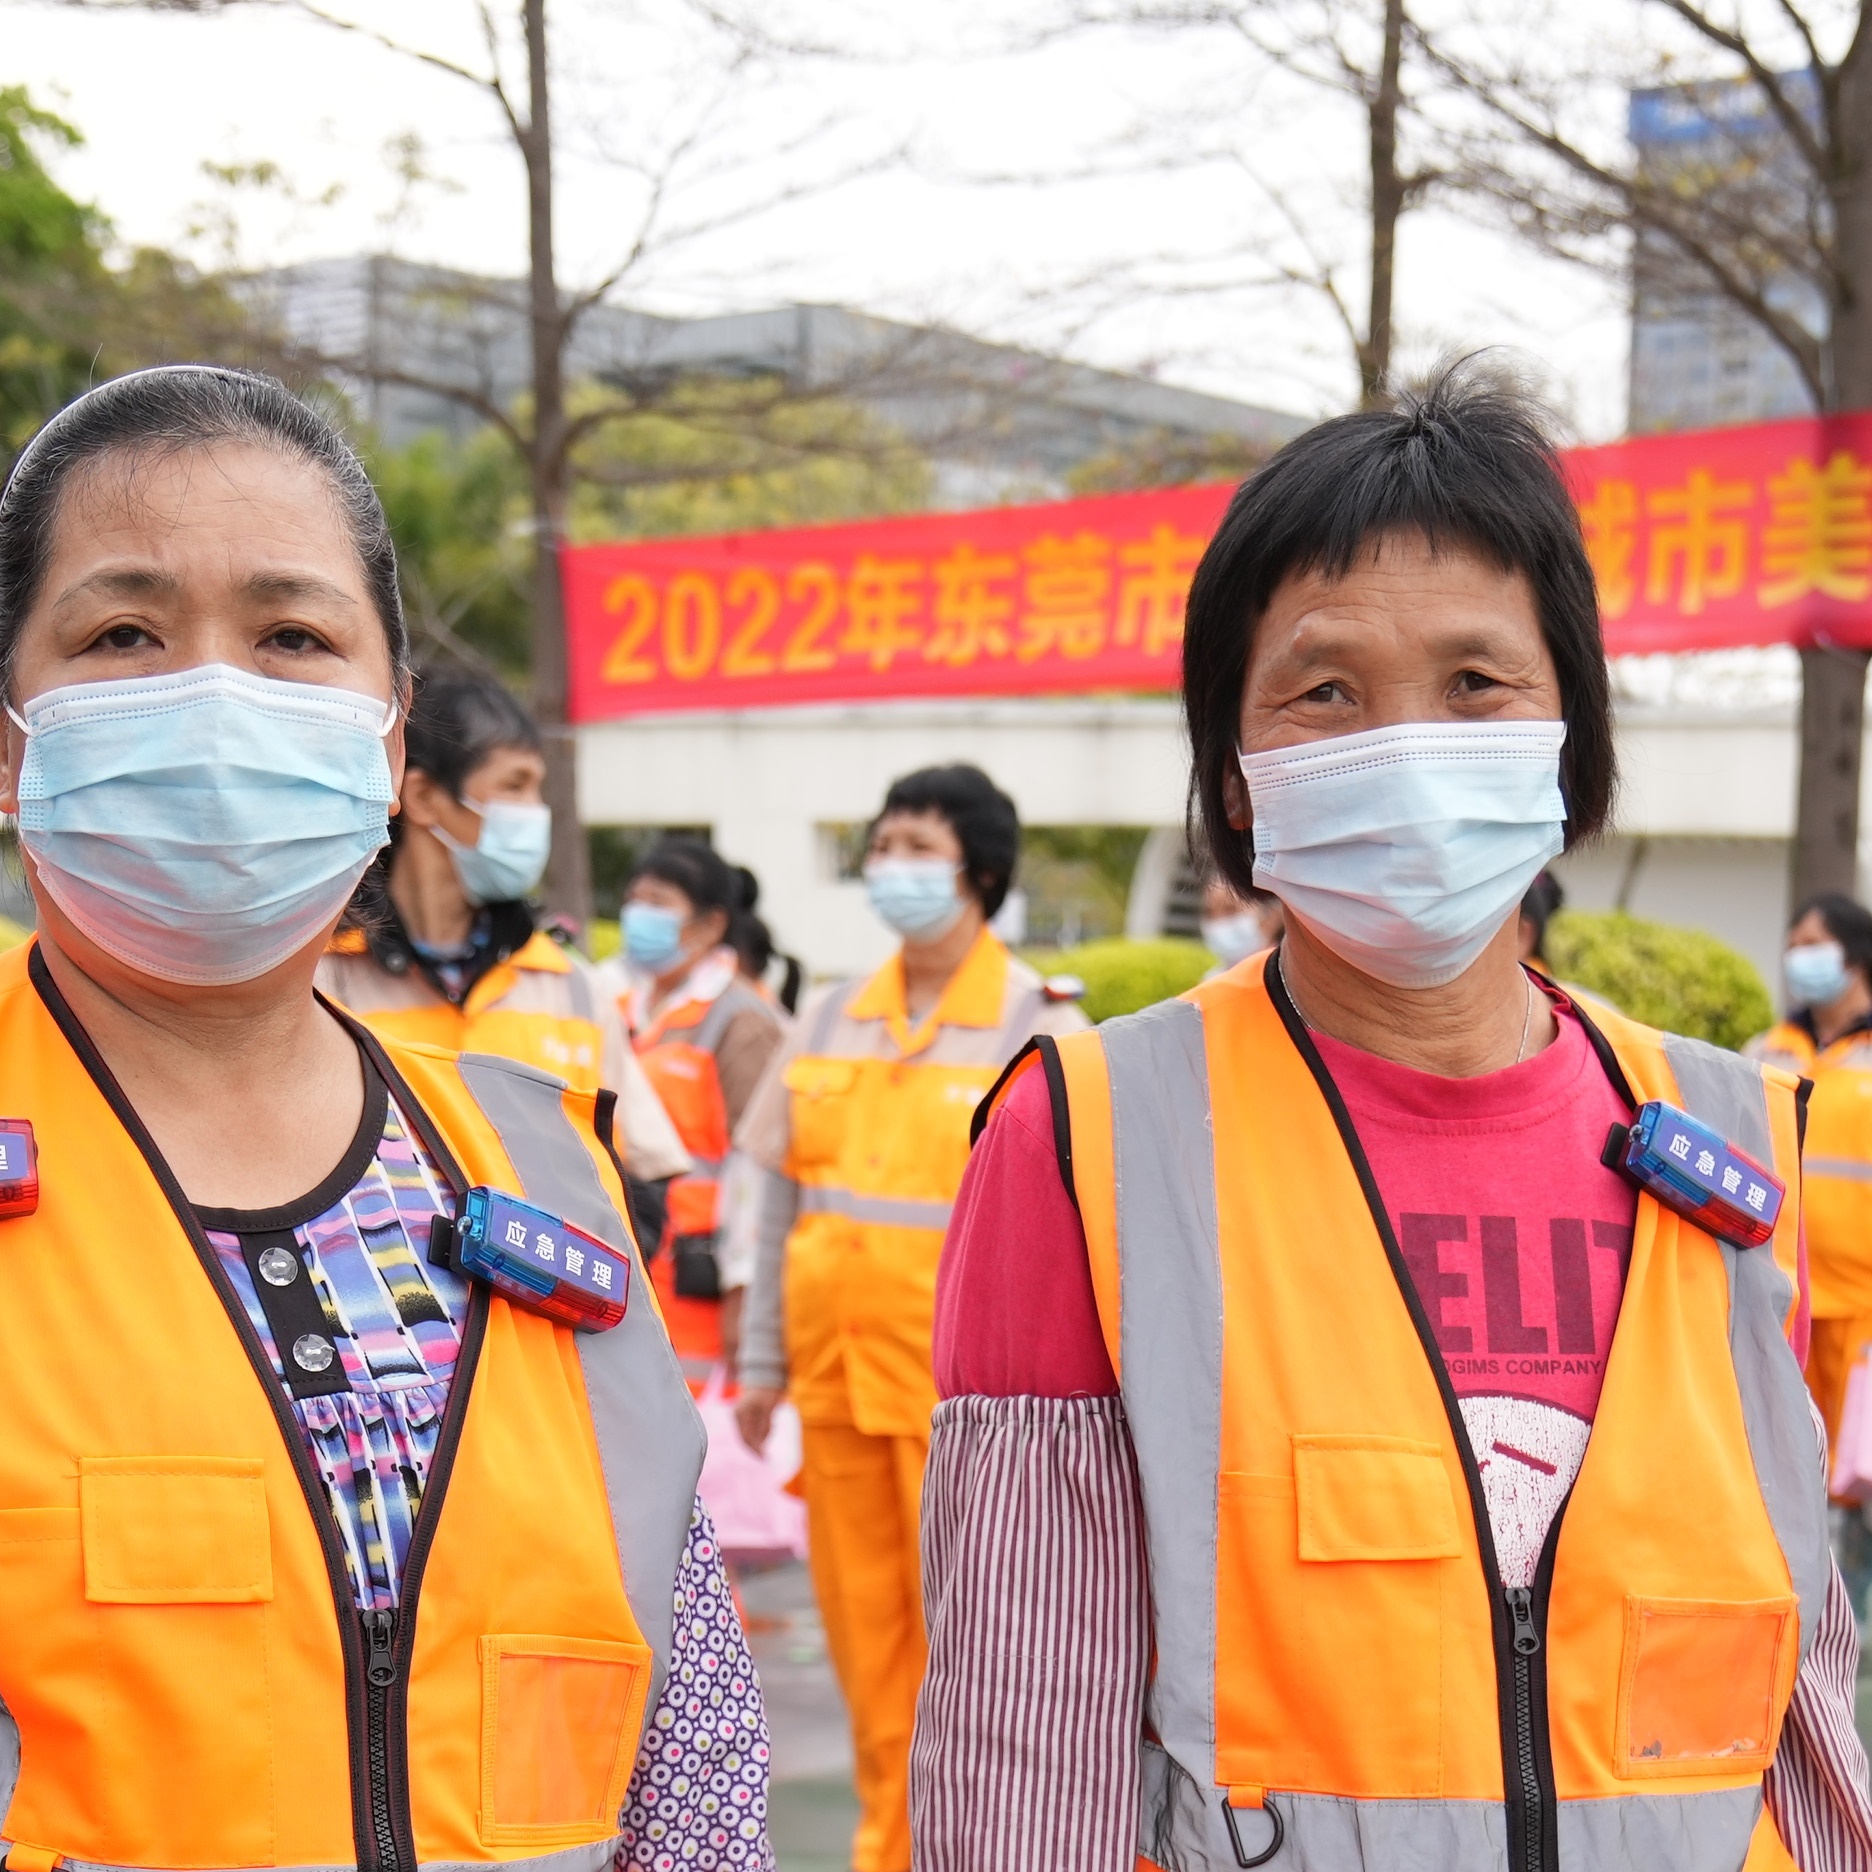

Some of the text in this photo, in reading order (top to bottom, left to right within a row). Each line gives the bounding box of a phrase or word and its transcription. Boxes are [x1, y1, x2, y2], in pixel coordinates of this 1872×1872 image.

[1668, 1132, 1769, 1214] 应急管理
[504, 1218, 616, 1292] 应急管理
[1506, 1359, 1602, 1376] COMPANY
